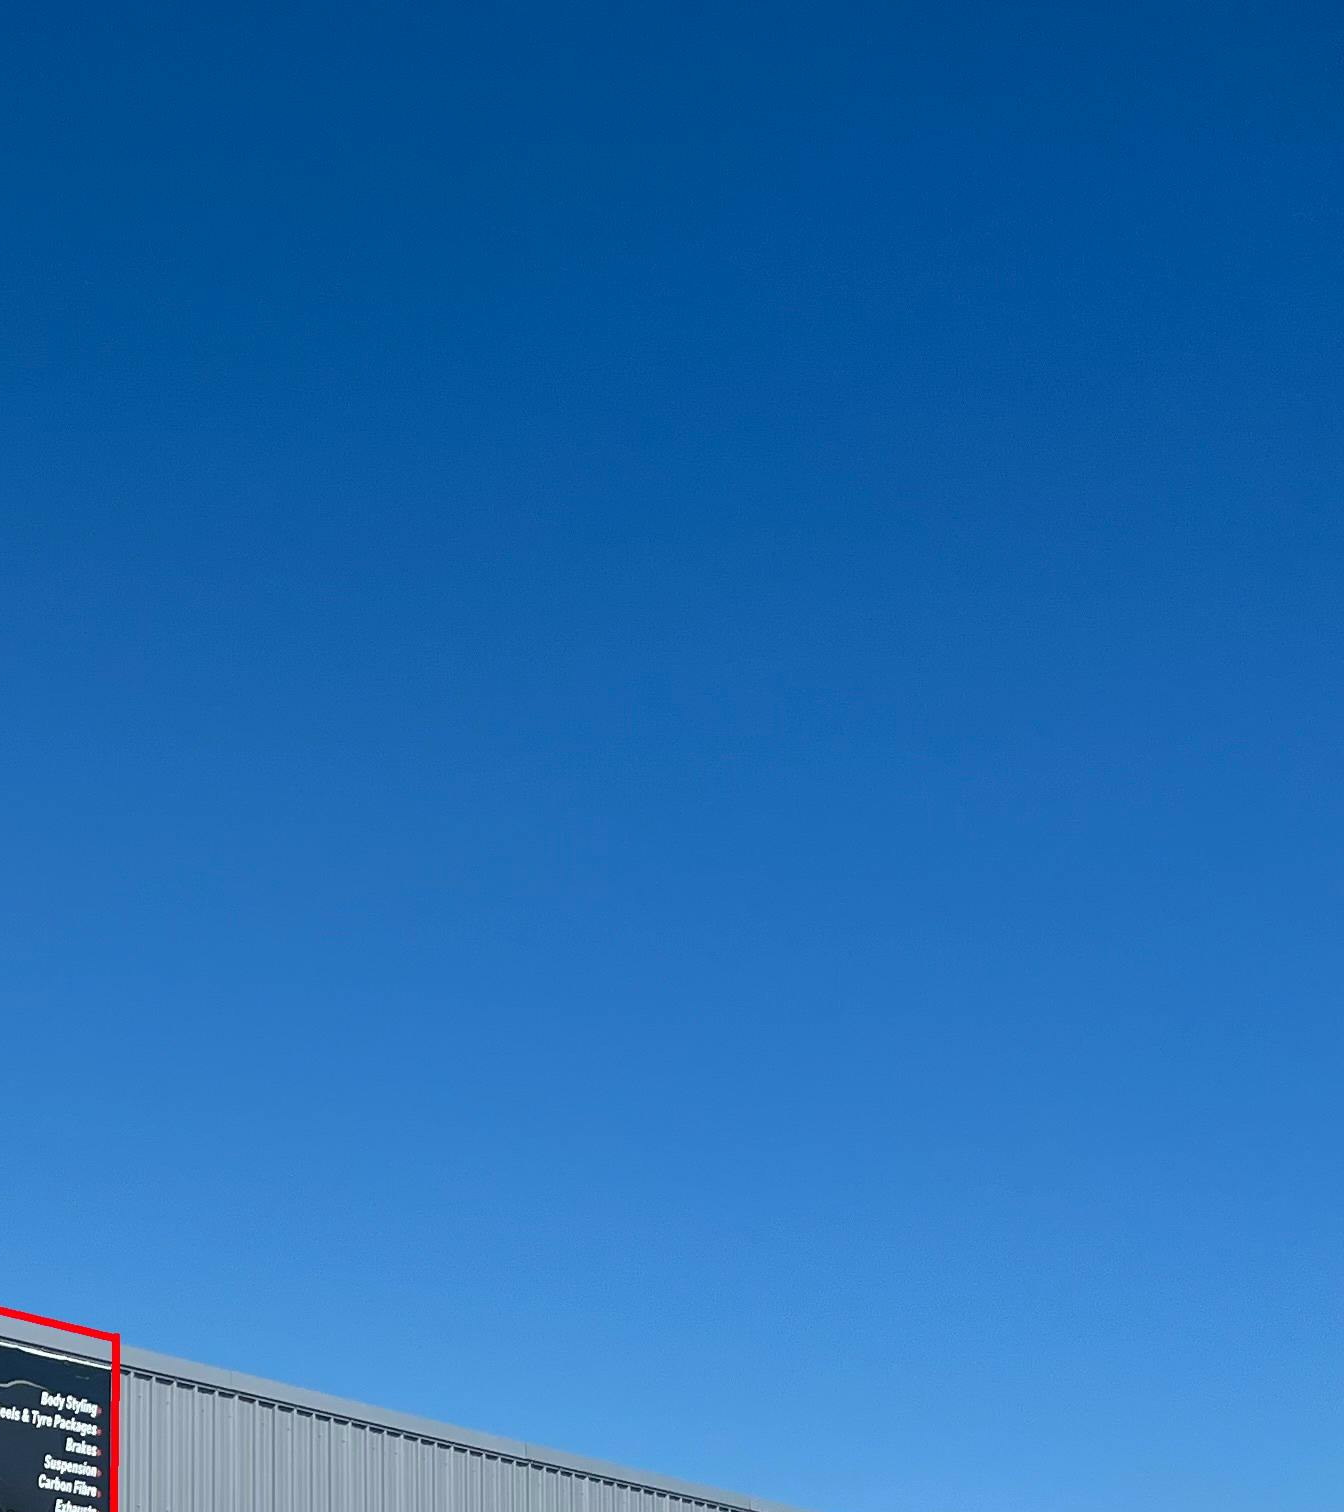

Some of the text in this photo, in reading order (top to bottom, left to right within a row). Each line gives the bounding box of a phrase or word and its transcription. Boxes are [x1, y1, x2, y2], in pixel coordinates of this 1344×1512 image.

[40, 1391, 98, 1418] Body Styling
[21, 1408, 30, 1422] &
[32, 1410, 53, 1428] Tyre
[53, 1414, 97, 1436] Packages
[65, 1437, 98, 1456] Brakes
[43, 1454, 97, 1477] Suspension
[38, 1474, 97, 1497] Carbon Fibre
